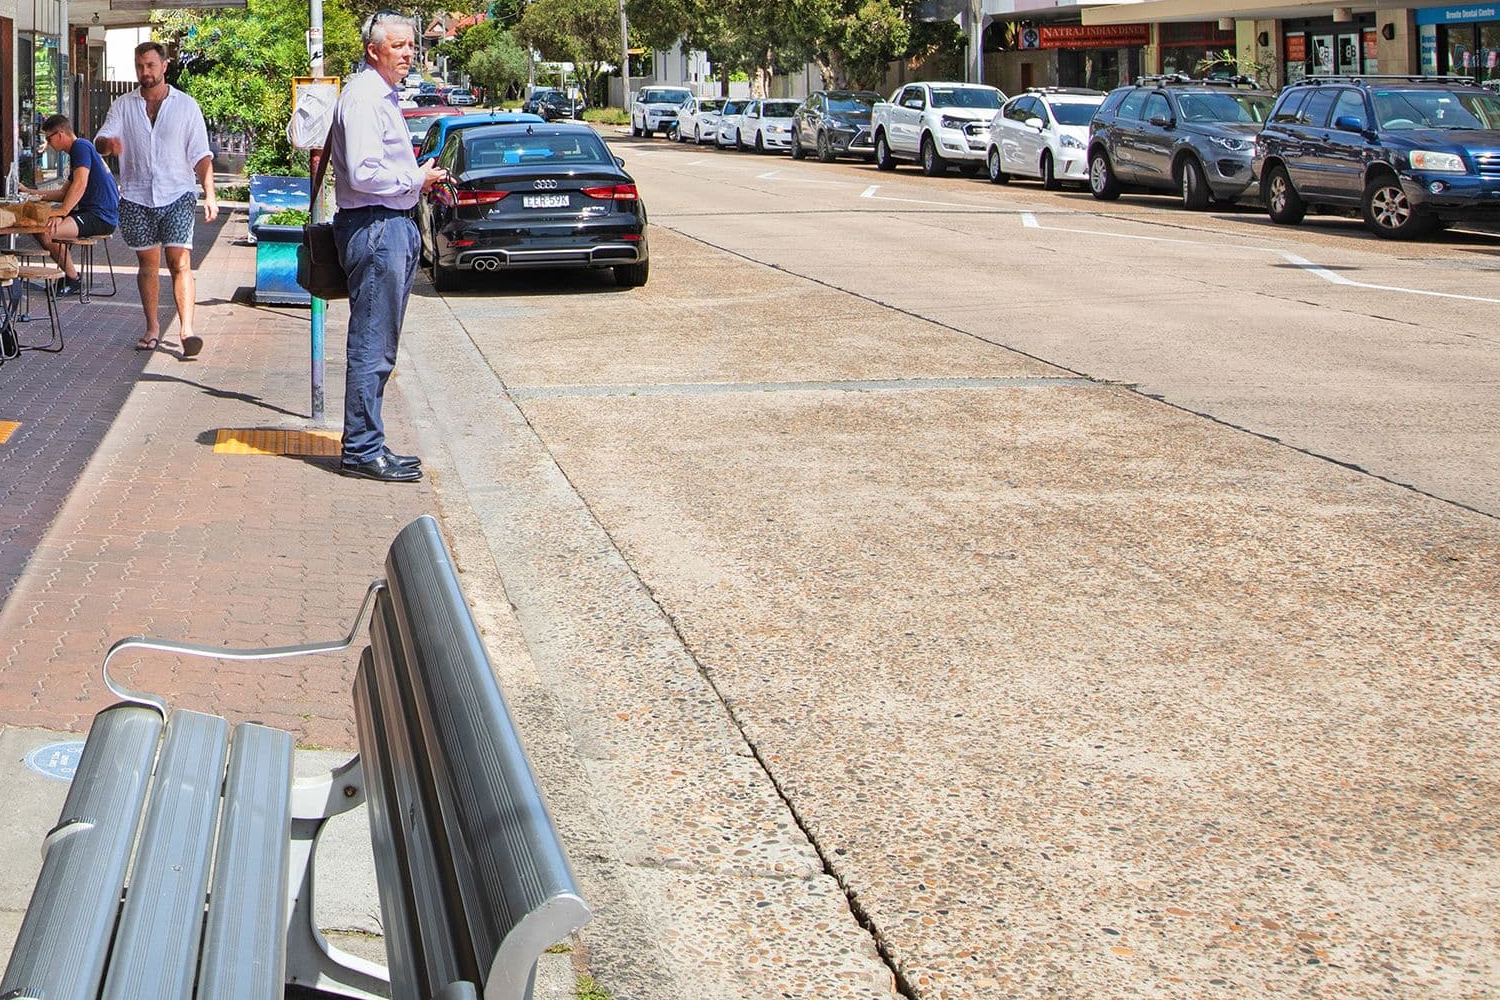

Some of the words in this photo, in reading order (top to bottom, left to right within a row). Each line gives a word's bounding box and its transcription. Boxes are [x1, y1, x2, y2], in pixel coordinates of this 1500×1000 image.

[1043, 26, 1085, 38] NATRAJ
[1087, 26, 1117, 37] INDIAN
[1118, 25, 1146, 35] DINER
